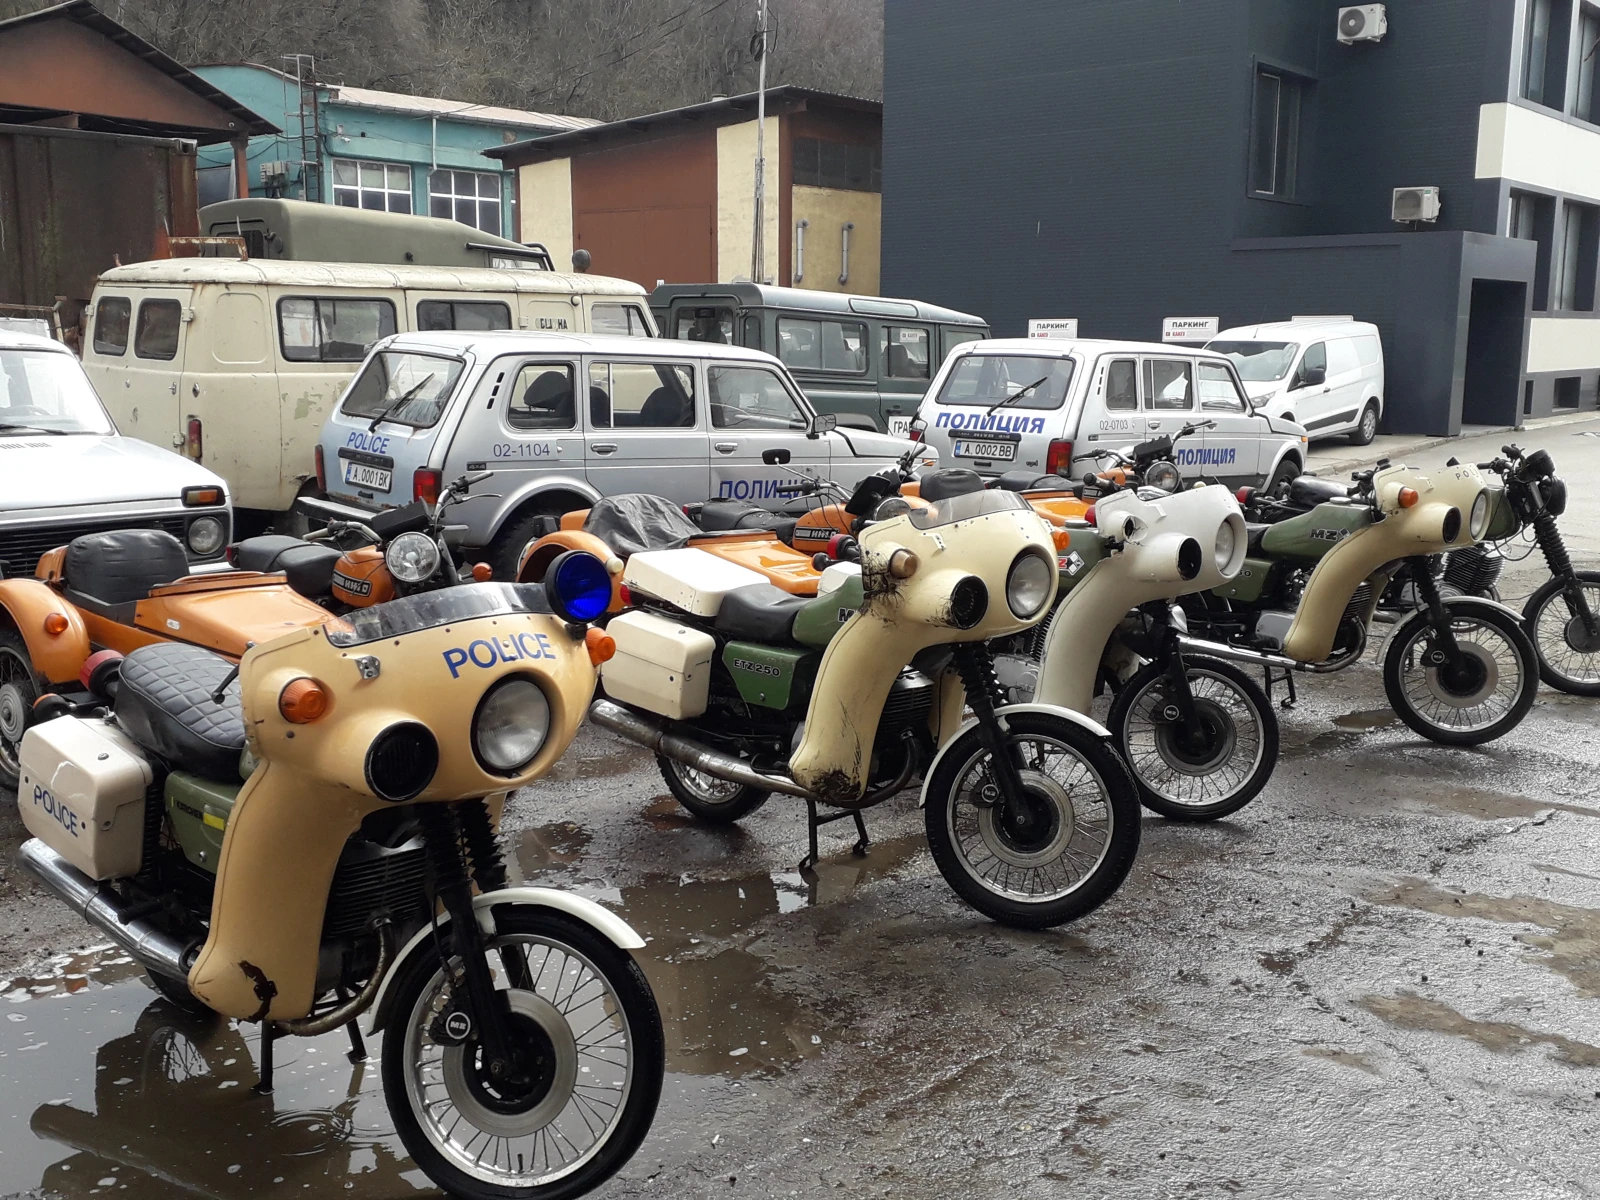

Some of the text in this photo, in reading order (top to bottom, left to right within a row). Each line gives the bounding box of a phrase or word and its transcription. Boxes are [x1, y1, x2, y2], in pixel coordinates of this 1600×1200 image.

[1036, 322, 1069, 330] ПАРКИНГ
[935, 412, 1046, 434] ПОЛИЦИЯ
[1100, 419, 1129, 431] 02-0703
[346, 431, 390, 455] POLICE
[493, 443, 550, 458] 02-1104
[1177, 448, 1236, 468] ПОЛИЦИЯ
[1310, 528, 1338, 541] MZ
[838, 607, 856, 622] M
[442, 632, 557, 679] POLICE
[33, 784, 78, 838] POLICE
